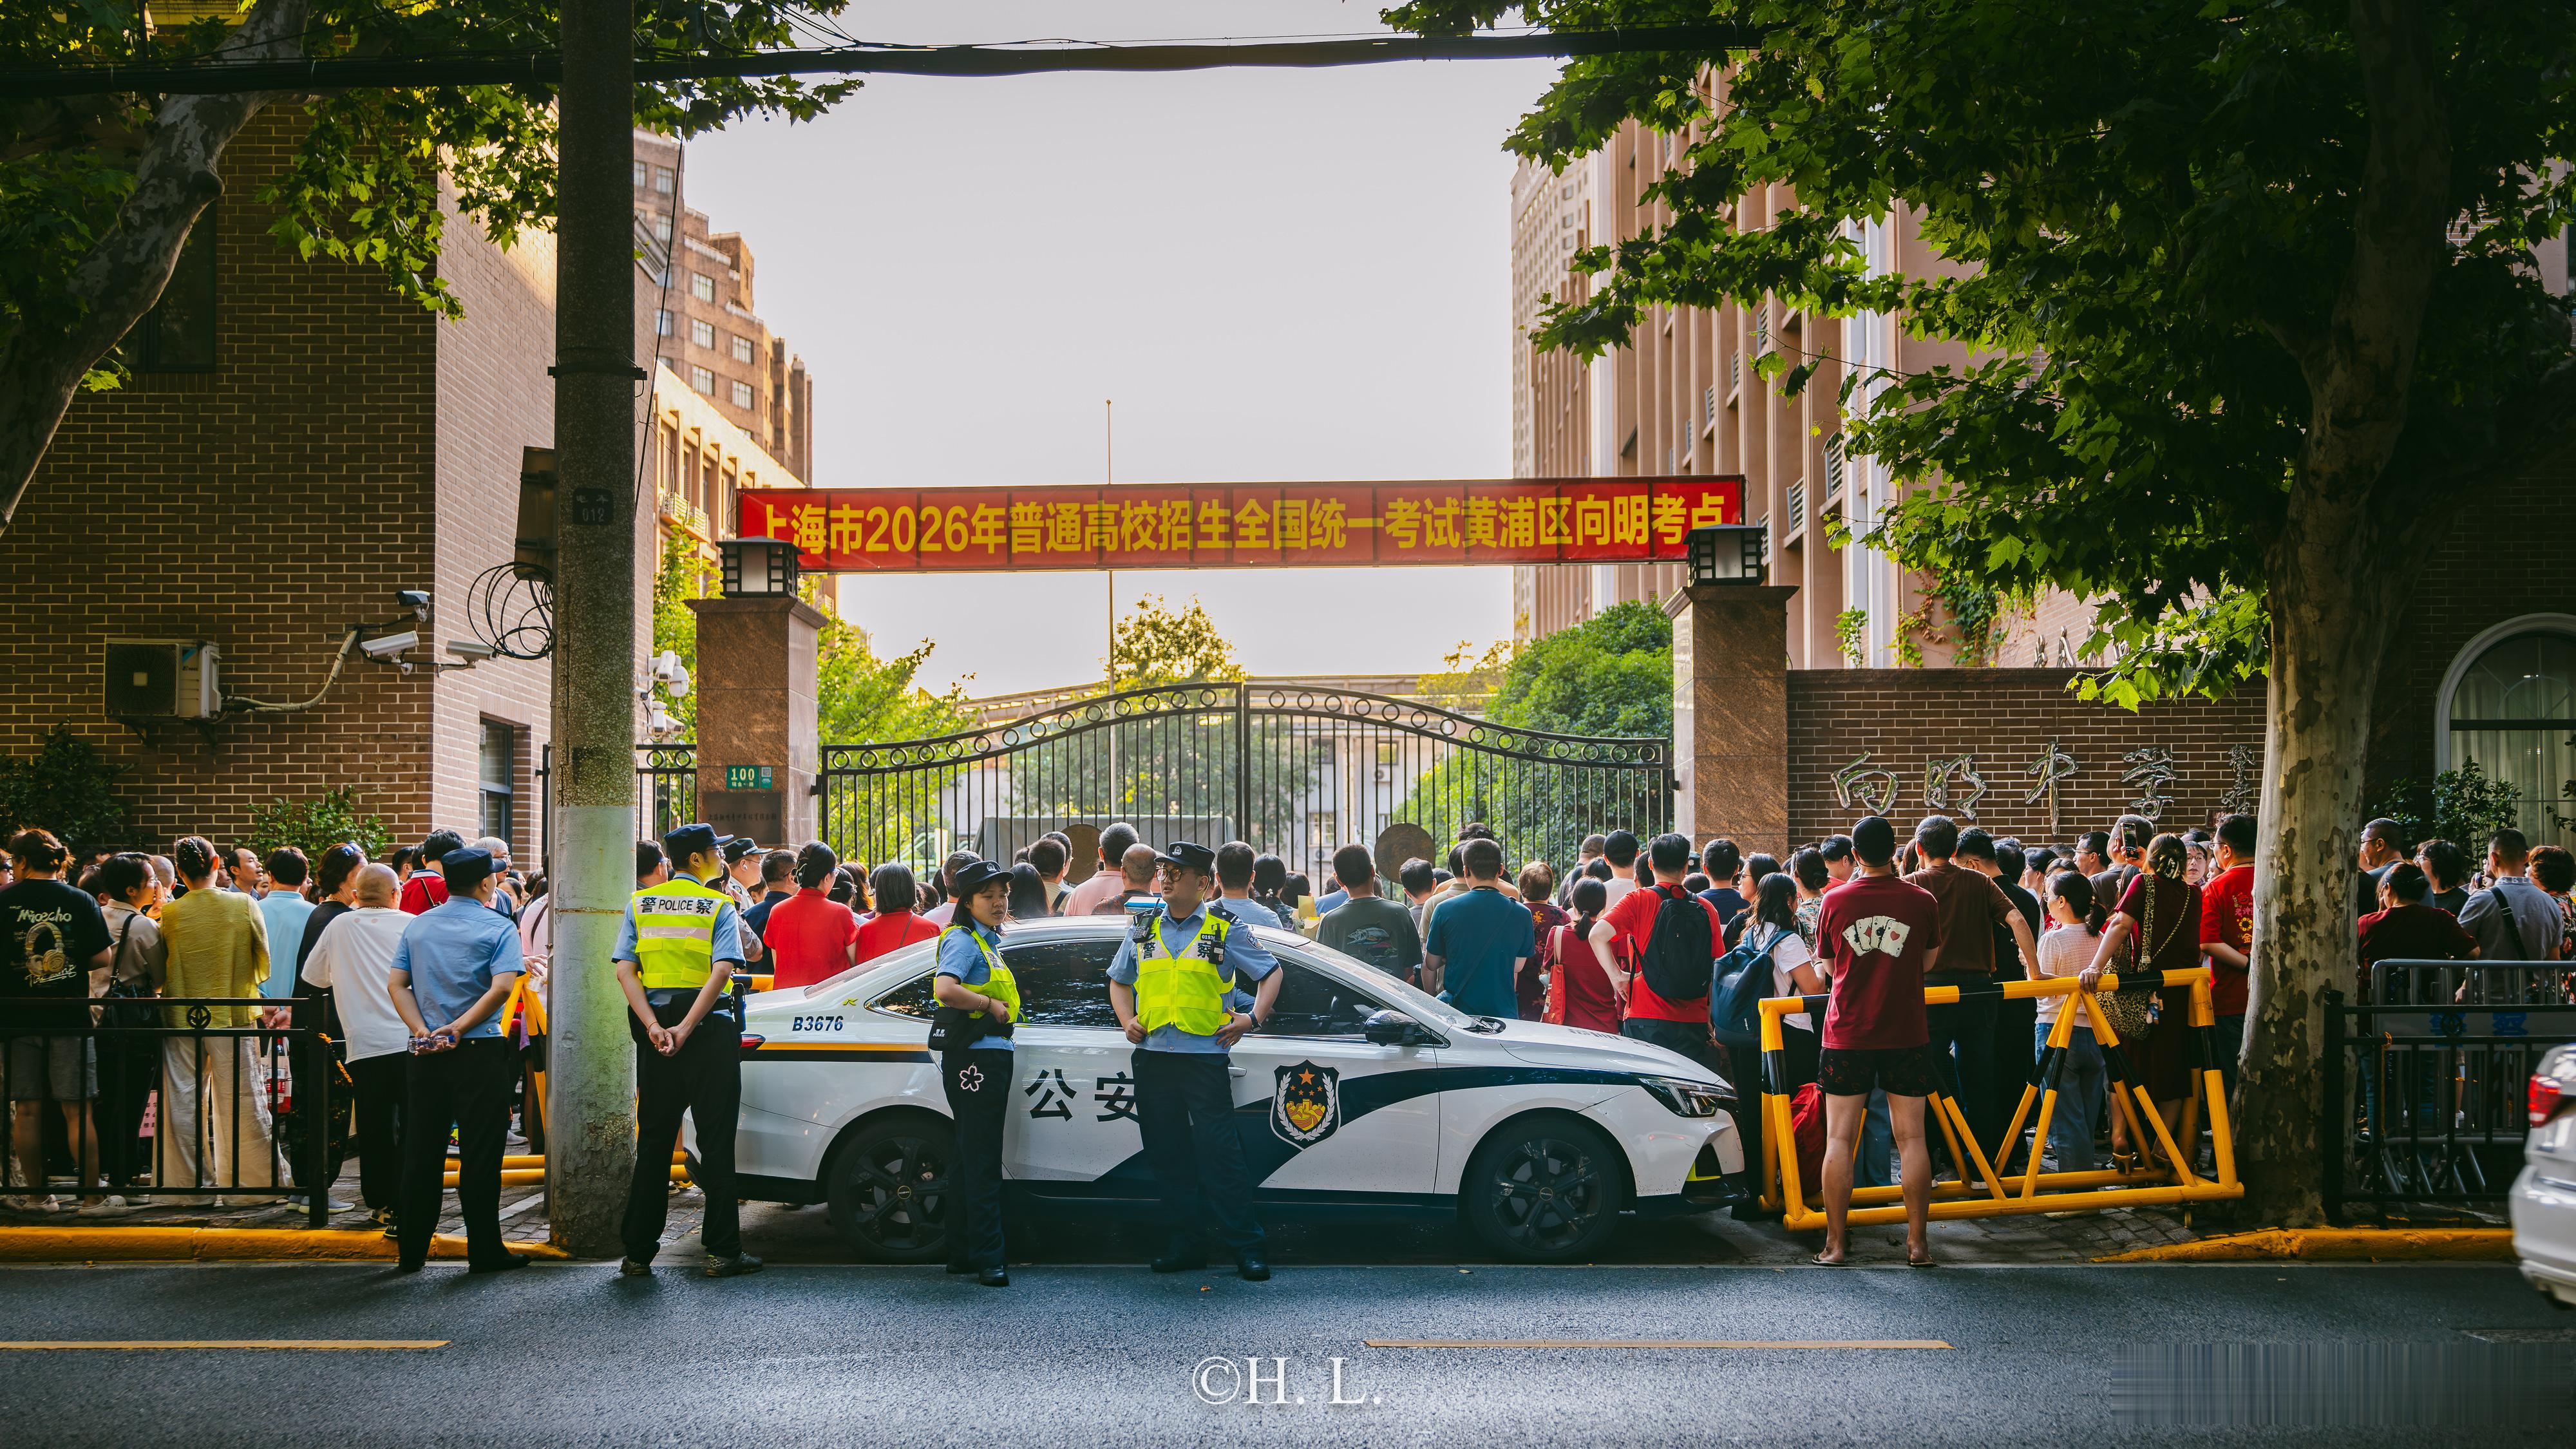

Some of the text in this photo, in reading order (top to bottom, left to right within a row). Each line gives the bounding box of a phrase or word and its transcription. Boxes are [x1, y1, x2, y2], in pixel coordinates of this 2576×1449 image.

[583, 507, 605, 522] 012
[766, 491, 1725, 554] 上海市2026年普通高校招生全国统一考试黄浦区向明考点
[731, 768, 755, 781] 100
[641, 896, 714, 914] 警 POLICE 察
[1143, 942, 1156, 959] 警
[792, 1016, 844, 1031] B3676
[1024, 1068, 1140, 1122] 公安
